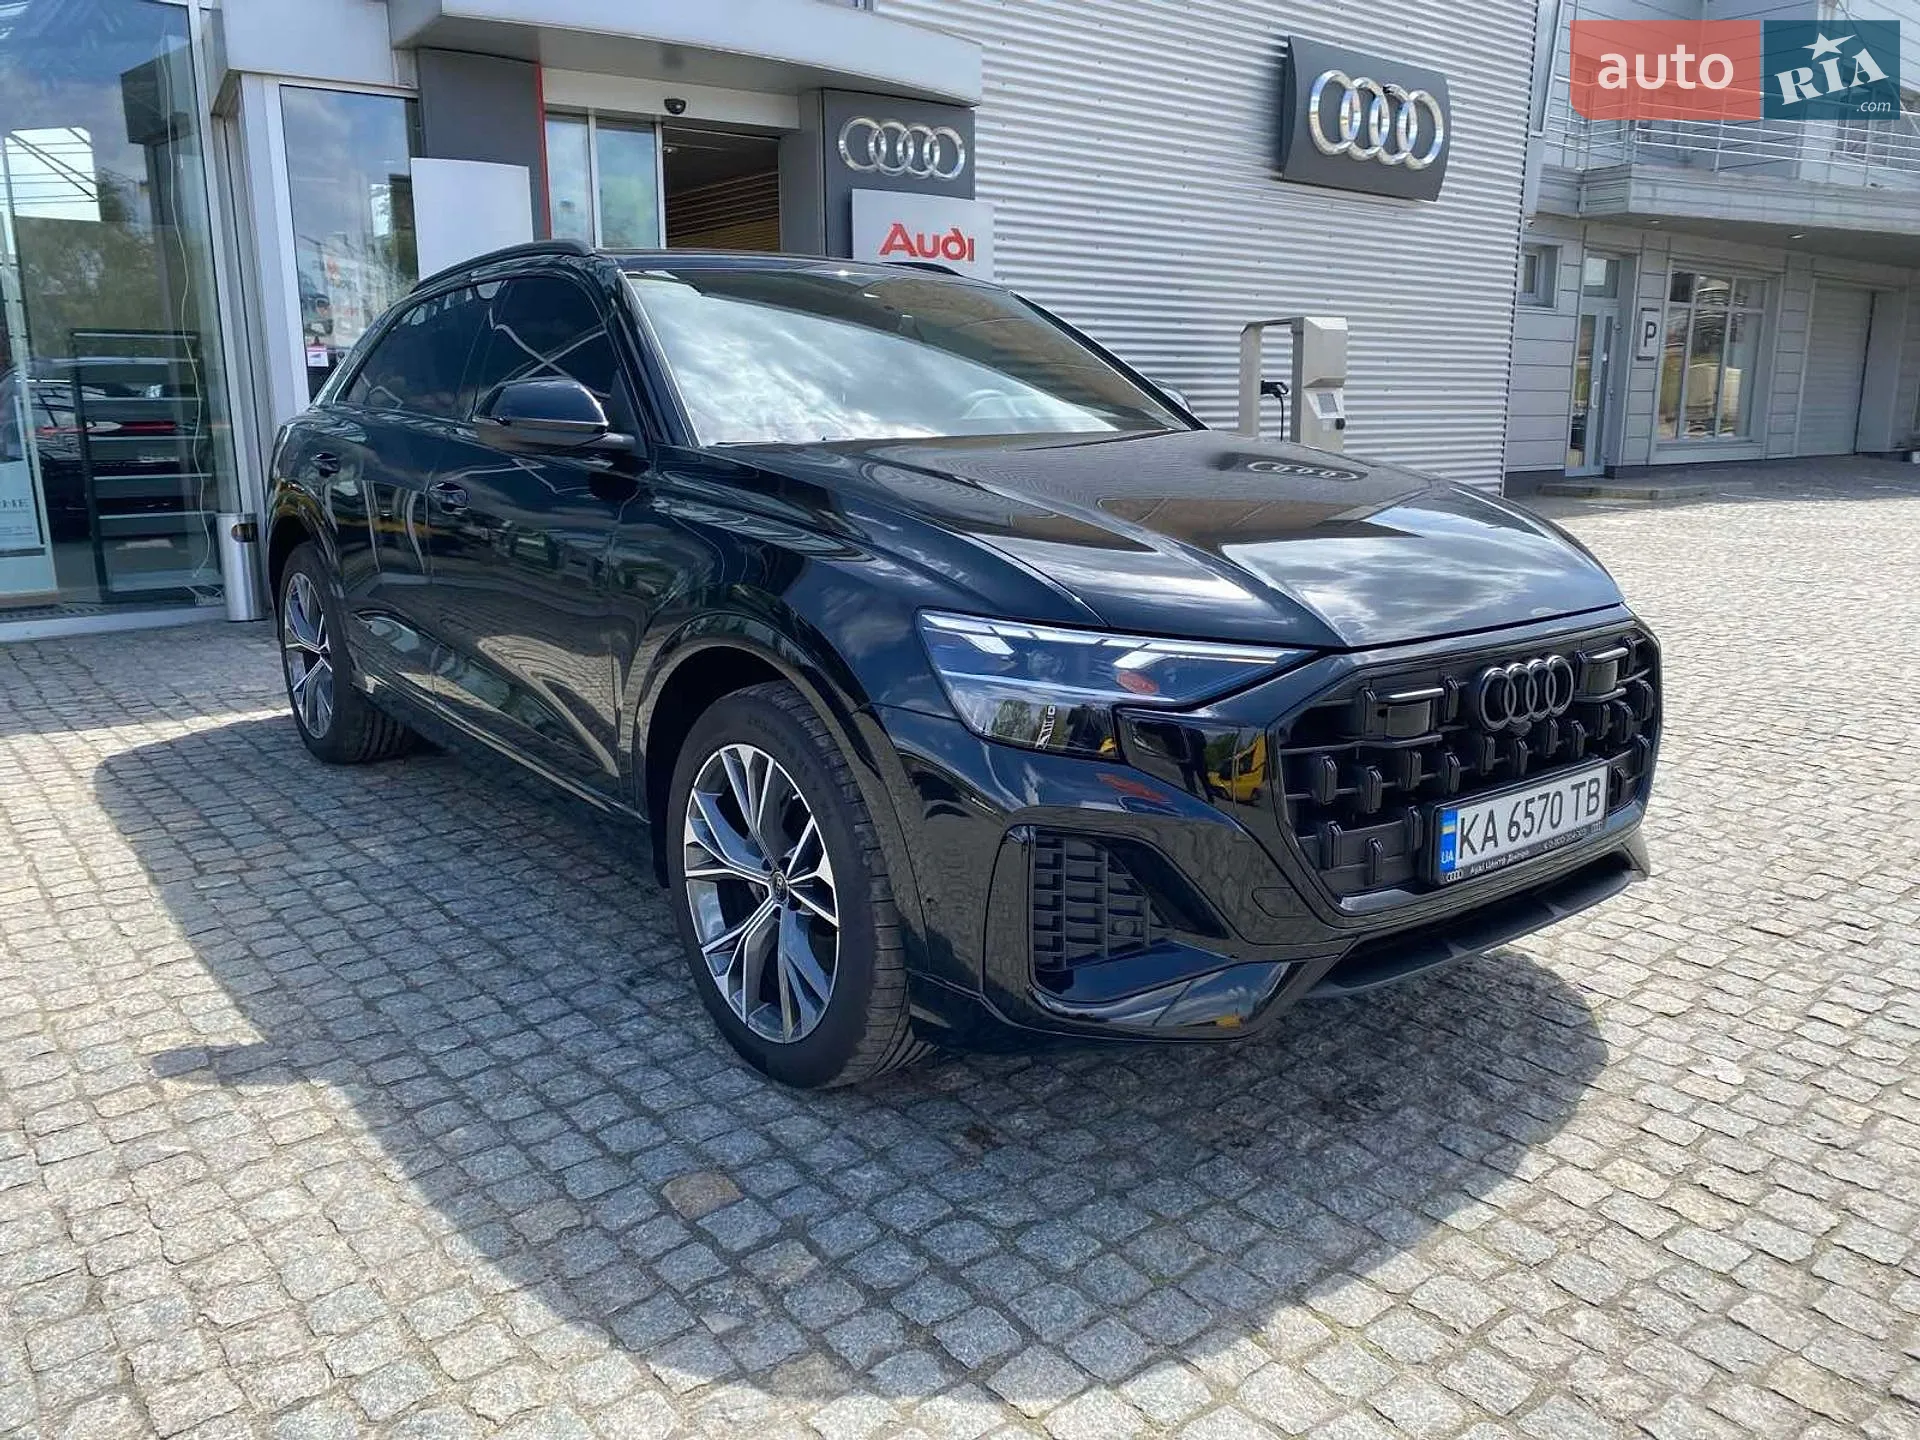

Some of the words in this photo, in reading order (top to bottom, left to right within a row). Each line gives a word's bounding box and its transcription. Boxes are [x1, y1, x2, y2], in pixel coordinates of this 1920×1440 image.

[879, 223, 975, 262] Audi
[1644, 320, 1657, 348] P
[1459, 807, 1499, 860] KA
[1507, 790, 1564, 843] 6570
[1571, 777, 1601, 821] TB
[1441, 849, 1454, 864] UA
